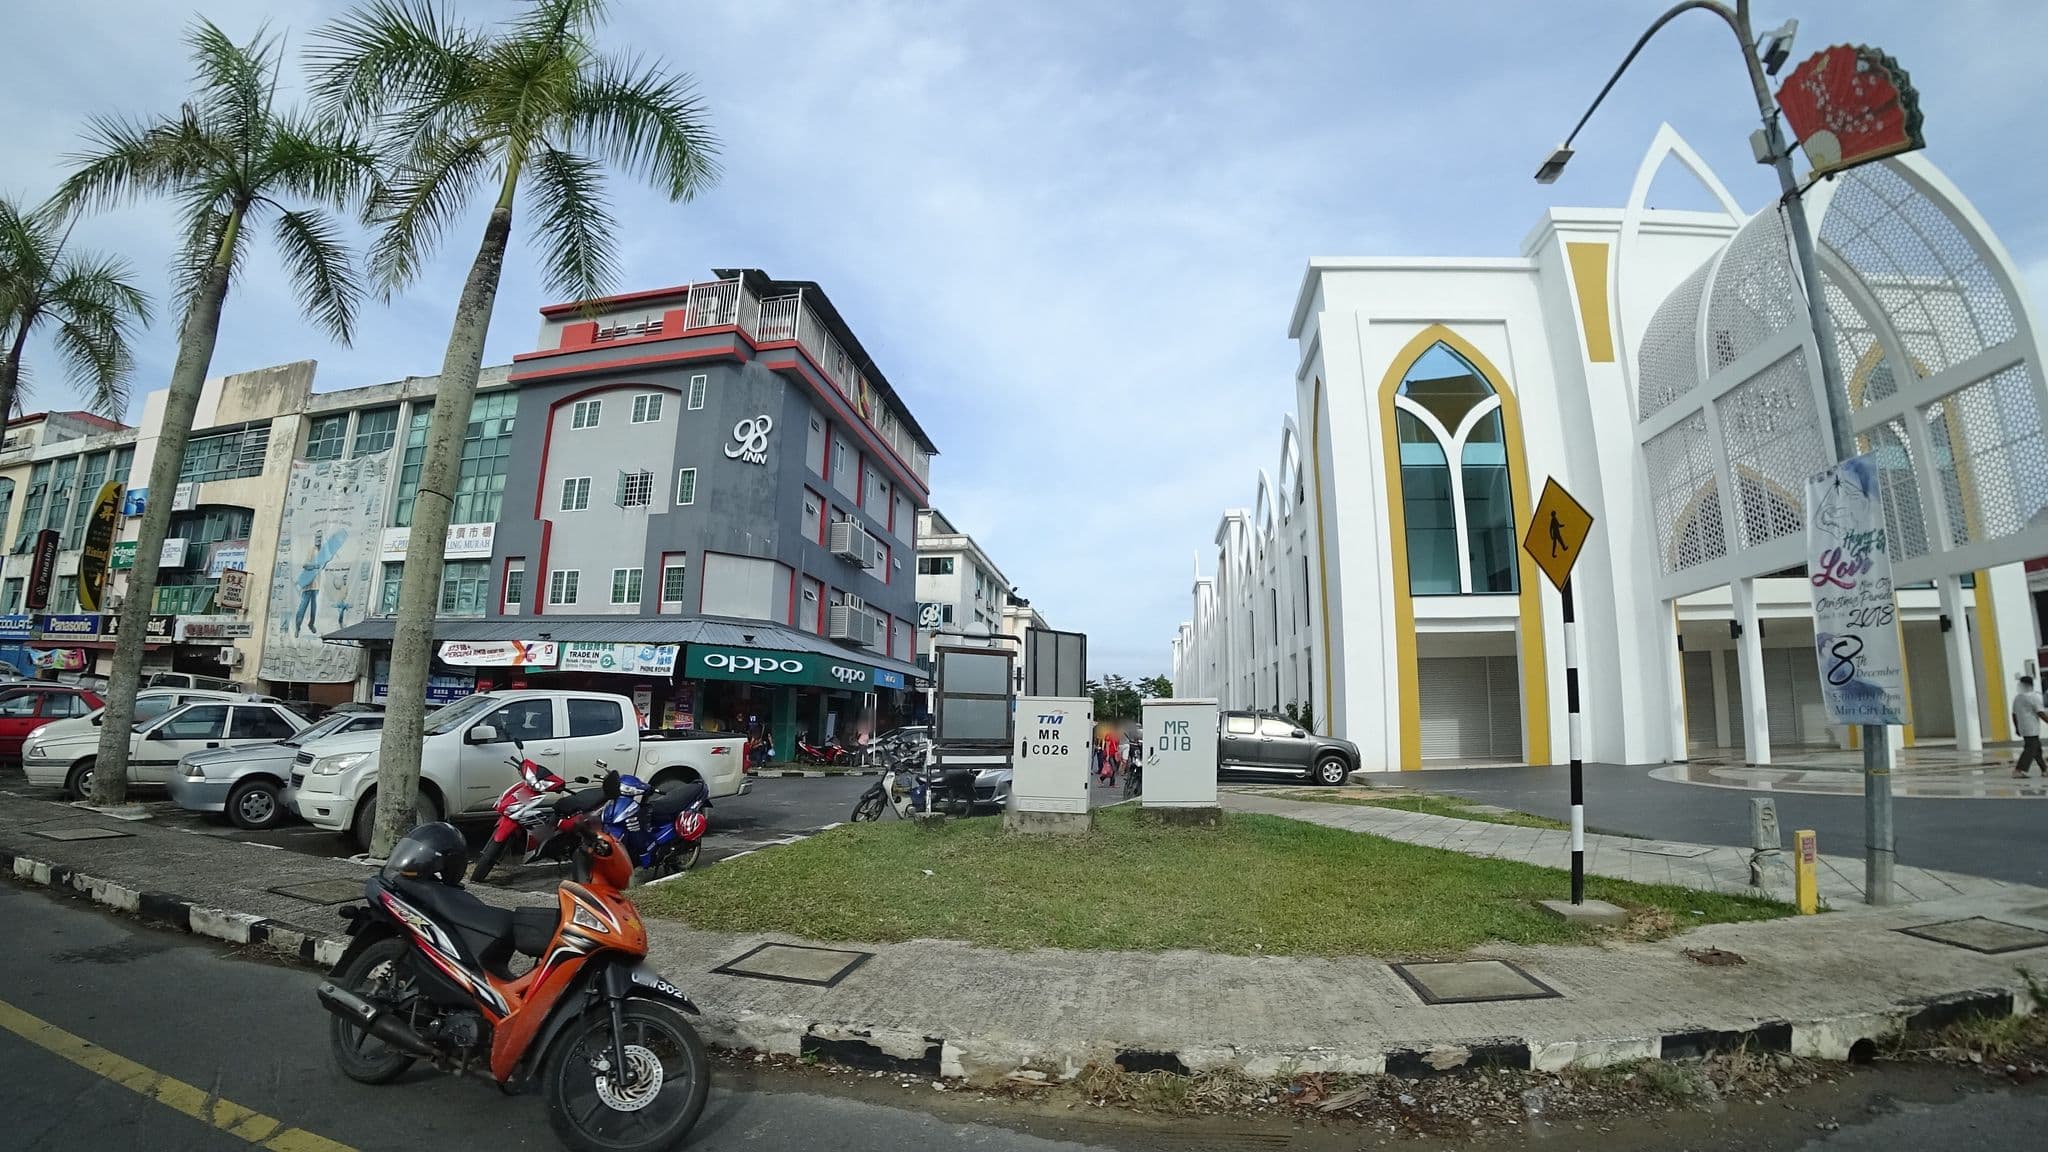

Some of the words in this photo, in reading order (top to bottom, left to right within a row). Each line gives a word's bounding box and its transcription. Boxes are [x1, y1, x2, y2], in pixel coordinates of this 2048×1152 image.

[724, 414, 773, 458] 98
[743, 451, 767, 465] INN
[1812, 547, 1875, 590] Love
[1846, 603, 1894, 628] 2018
[49, 617, 92, 632] Panasonic
[146, 617, 168, 635] sing
[1827, 634, 1864, 686] 8
[1856, 666, 1900, 678] December
[1037, 715, 1064, 725] TM
[1164, 720, 1189, 735] MR
[1032, 744, 1069, 755] C026
